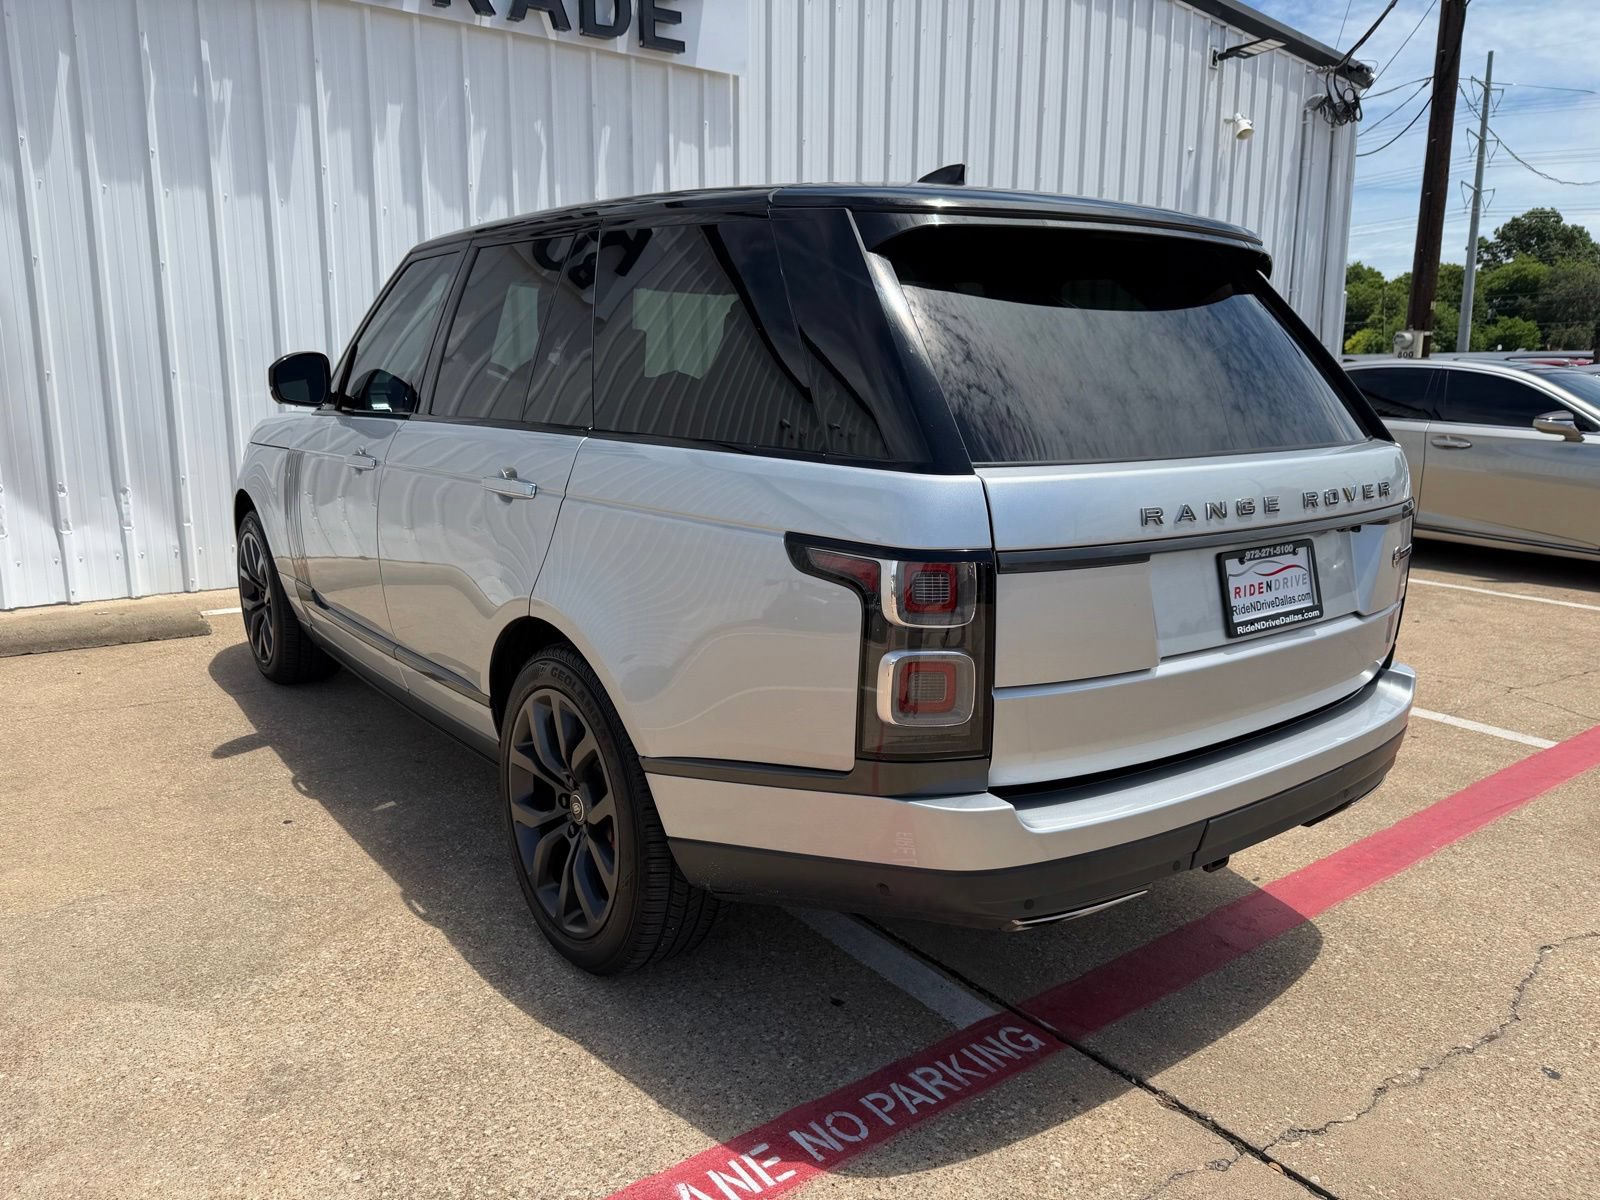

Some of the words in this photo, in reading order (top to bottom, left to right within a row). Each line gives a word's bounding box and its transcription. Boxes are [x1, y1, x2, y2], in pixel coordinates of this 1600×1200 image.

[1140, 496, 1281, 526] RANGE
[1302, 481, 1391, 509] ROVER
[1244, 544, 1294, 560] 972-271-5100
[1231, 591, 1312, 616] RideNDriveDallas.com
[1236, 609, 1320, 635] RideNDriveDallas.com
[788, 1110, 870, 1162] NO
[858, 1026, 1047, 1127] PARKING
